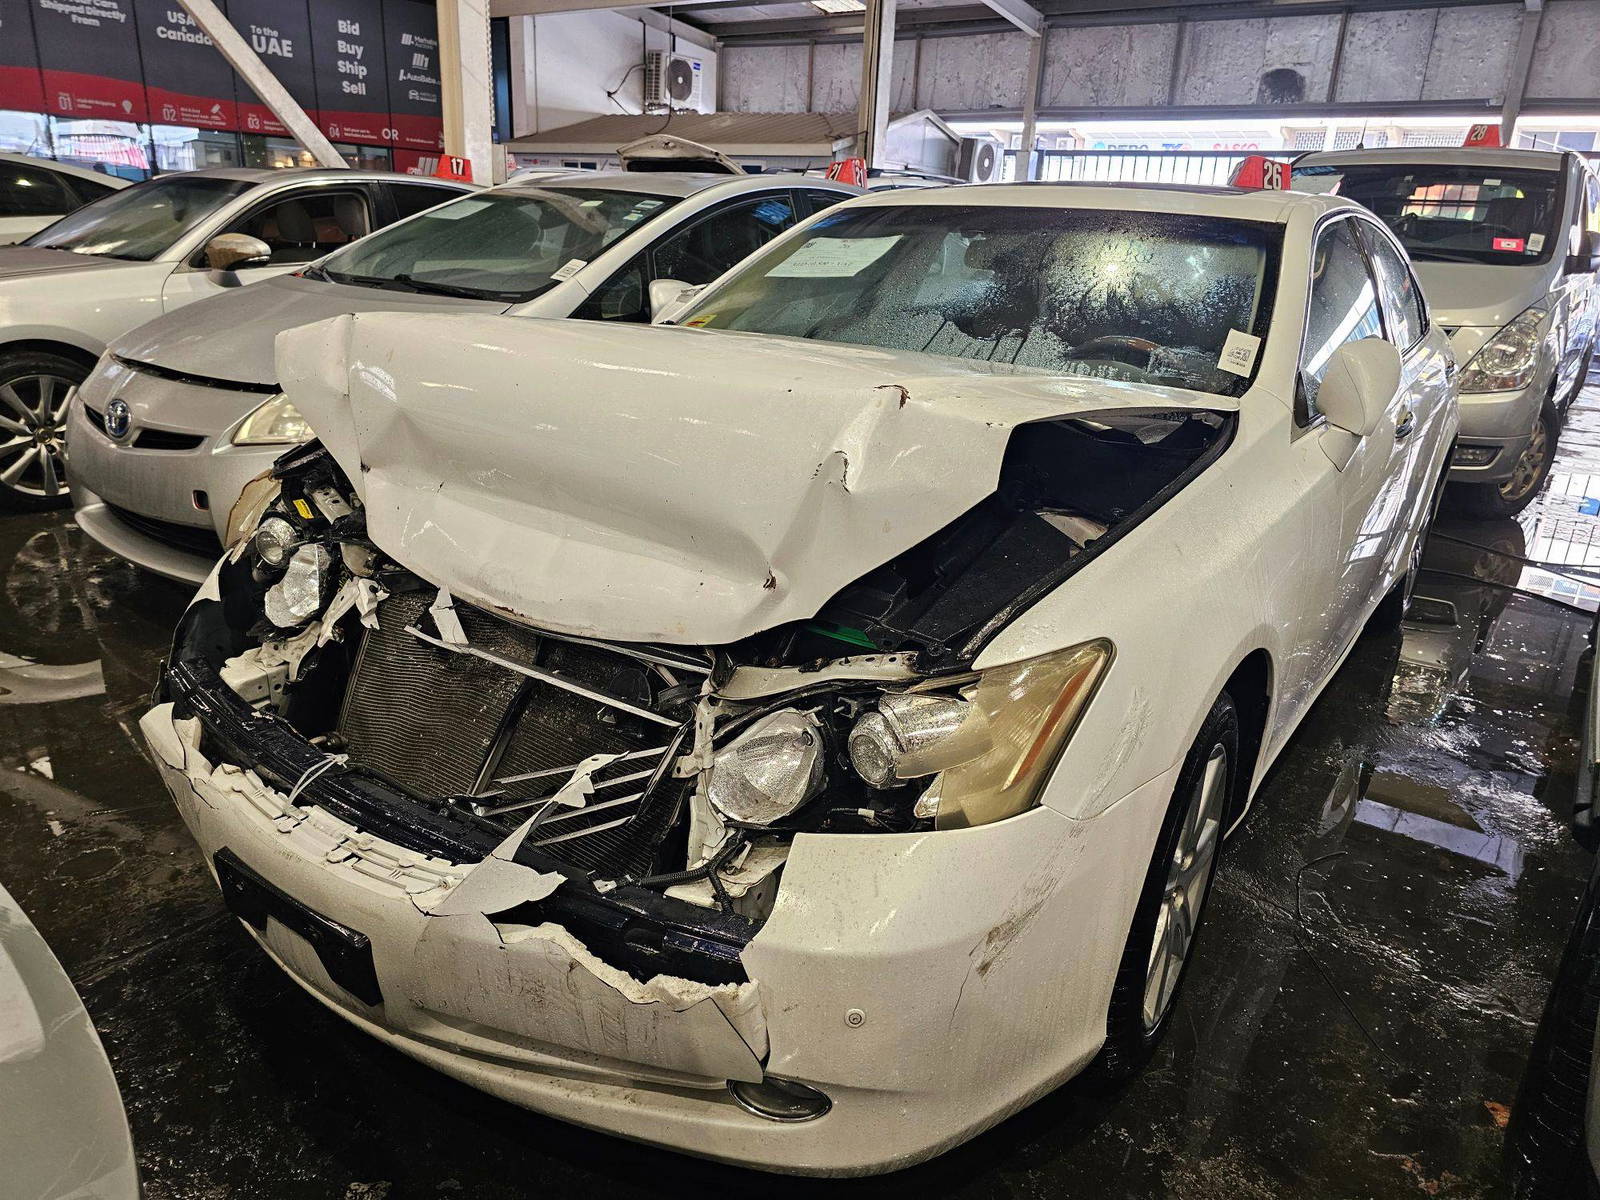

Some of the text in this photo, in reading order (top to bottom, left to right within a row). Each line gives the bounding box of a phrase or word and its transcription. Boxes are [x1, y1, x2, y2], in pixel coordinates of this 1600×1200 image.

[40, 0, 127, 23] Shipped Directly
[167, 11, 196, 27] USA
[71, 14, 100, 27] From
[338, 20, 360, 36] Bid
[156, 26, 214, 46] Canada
[250, 25, 279, 38] To the
[252, 34, 294, 58] UAE
[337, 40, 364, 60] Buy
[337, 60, 368, 80] Ship
[342, 81, 366, 96] Sell
[163, 108, 177, 122] 02
[248, 117, 260, 129] 03
[329, 127, 340, 138] 04
[382, 128, 399, 140] OR
[1471, 125, 1488, 141] 28
[451, 158, 464, 176] 17
[829, 163, 843, 180] 21
[1263, 161, 1282, 190] 26
